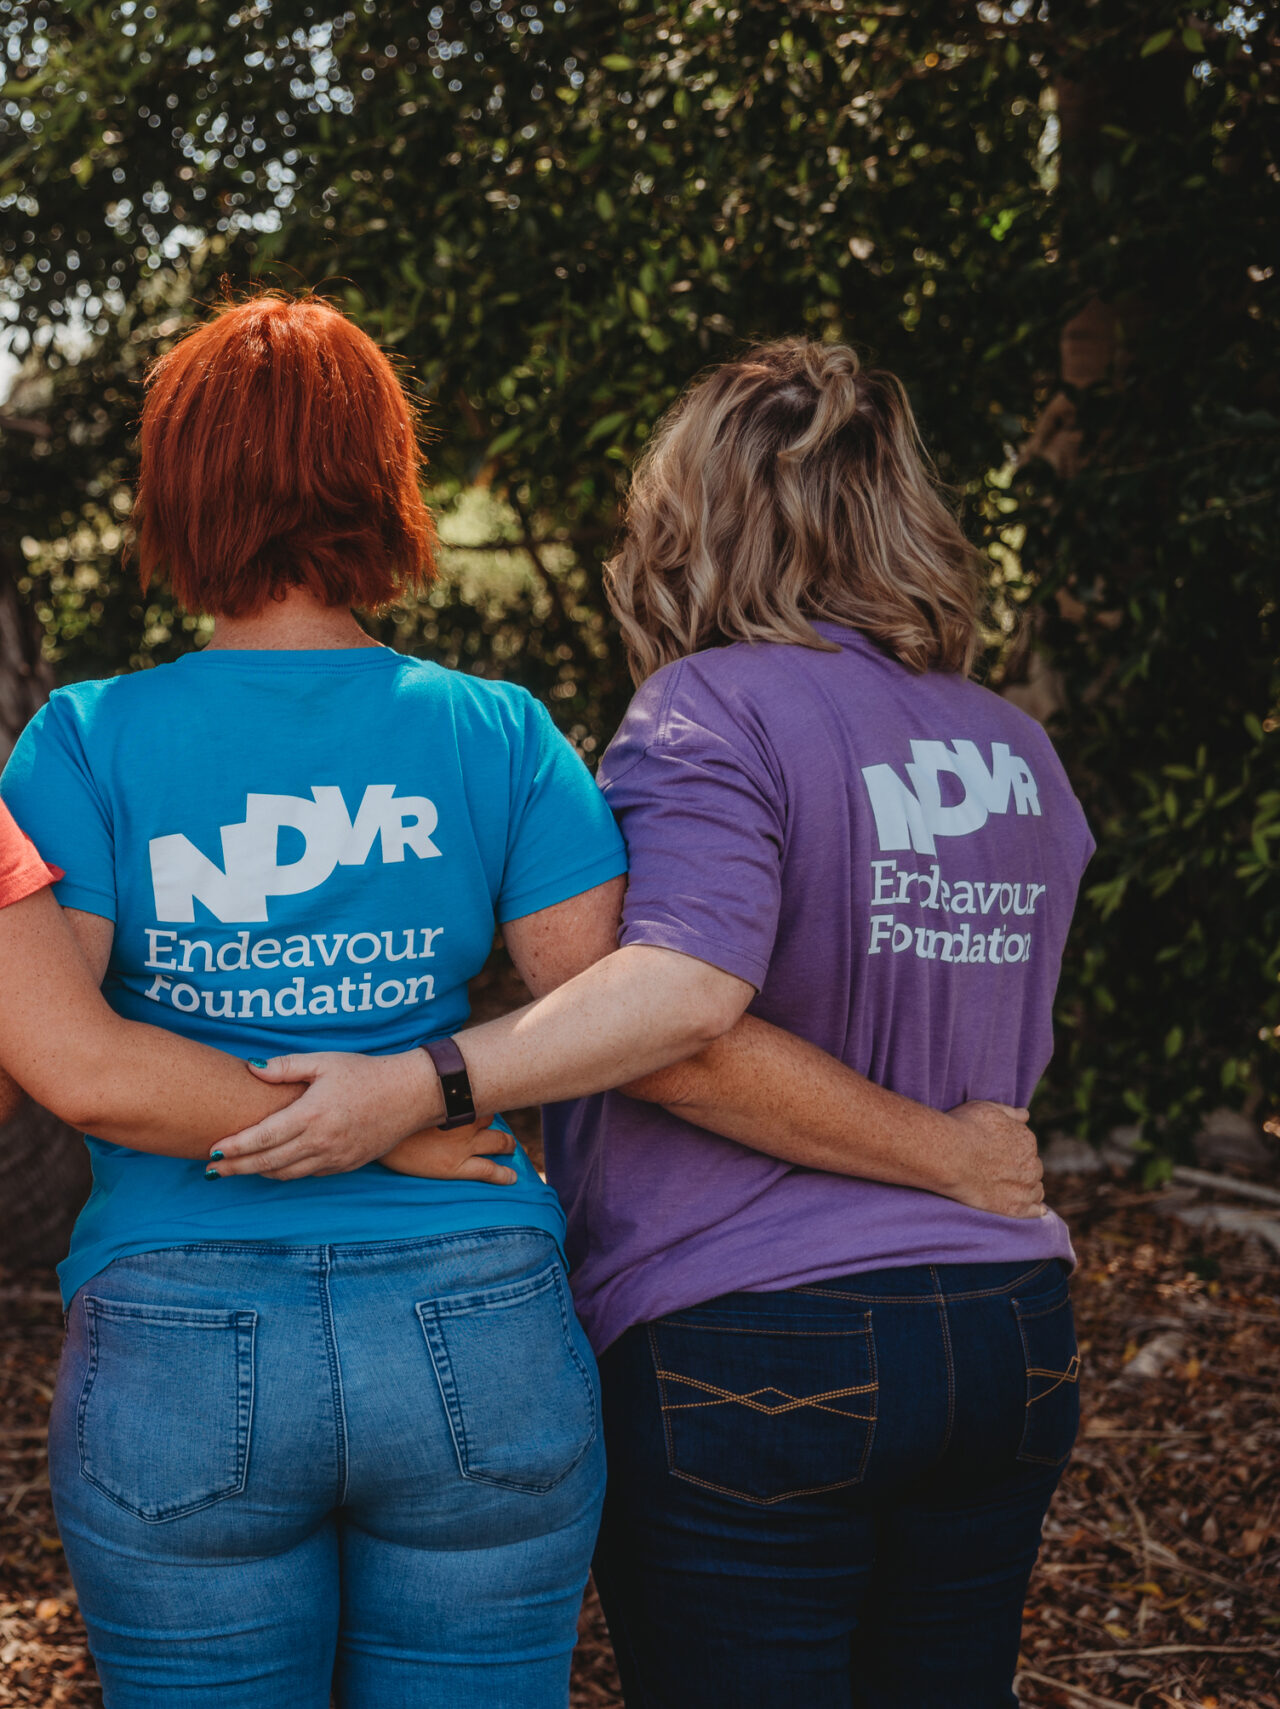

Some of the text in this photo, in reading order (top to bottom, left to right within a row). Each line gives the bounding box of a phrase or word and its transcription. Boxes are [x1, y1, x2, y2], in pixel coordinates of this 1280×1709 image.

[861, 739, 1042, 858] NDVR
[149, 784, 443, 923] NDVR
[144, 926, 444, 972] Endeavour
[868, 914, 1031, 964] Foundaton
